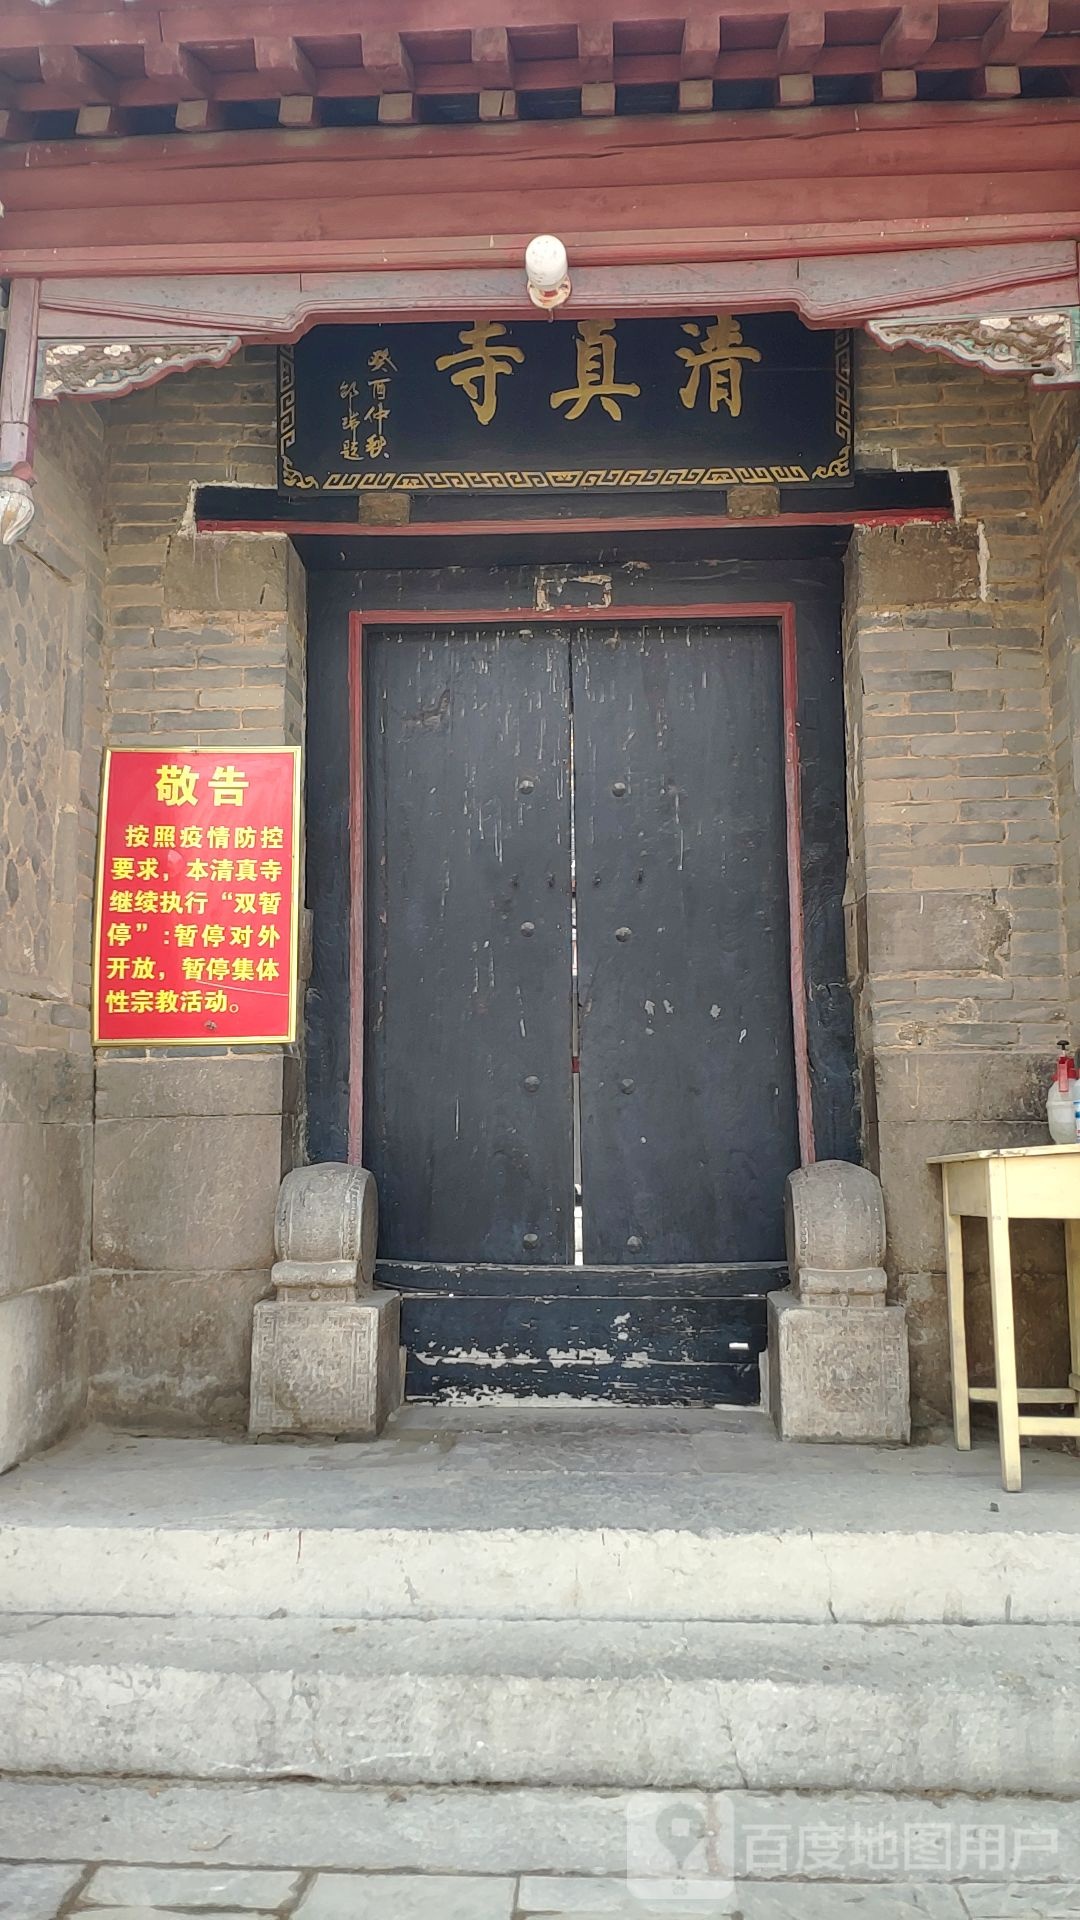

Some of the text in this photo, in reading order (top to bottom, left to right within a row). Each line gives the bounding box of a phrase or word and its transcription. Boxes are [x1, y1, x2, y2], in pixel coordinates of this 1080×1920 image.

[435, 314, 761, 425] 清真寺
[156, 765, 249, 807] 敬告
[125, 825, 284, 849] 按照疫情防控
[111, 857, 282, 882] 要求，本清真寺
[106, 957, 280, 982] 开放，暂停集体
[106, 990, 239, 1014] 性宗教活动。
